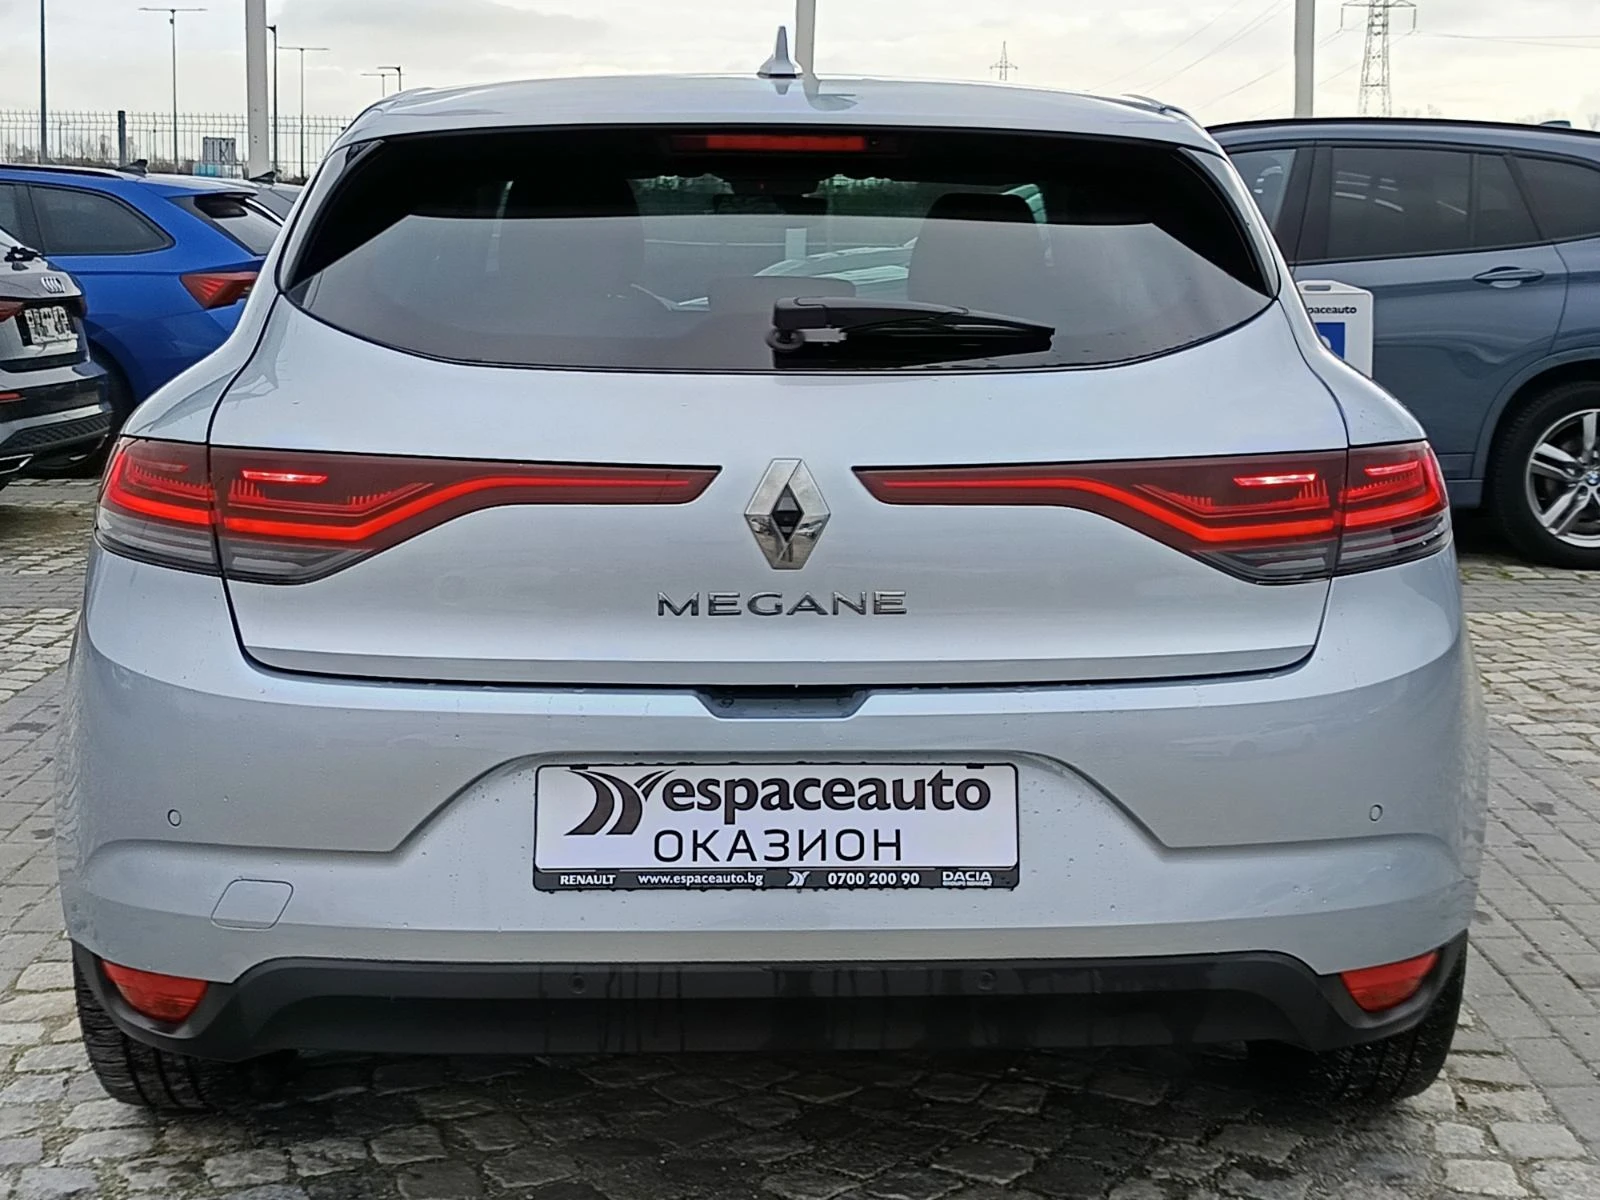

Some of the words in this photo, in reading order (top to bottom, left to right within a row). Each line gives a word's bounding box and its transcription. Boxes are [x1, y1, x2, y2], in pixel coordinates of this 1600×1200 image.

[657, 590, 907, 616] MEGANE
[662, 769, 991, 825] espaceauto
[653, 829, 902, 863] ОКАЗИОН
[560, 874, 616, 885] RENAULT
[637, 872, 764, 886] www.espaceauto.bg
[827, 872, 865, 885] 0700
[868, 872, 897, 885] 200
[900, 872, 920, 885] 90
[942, 871, 992, 881] DACIA
